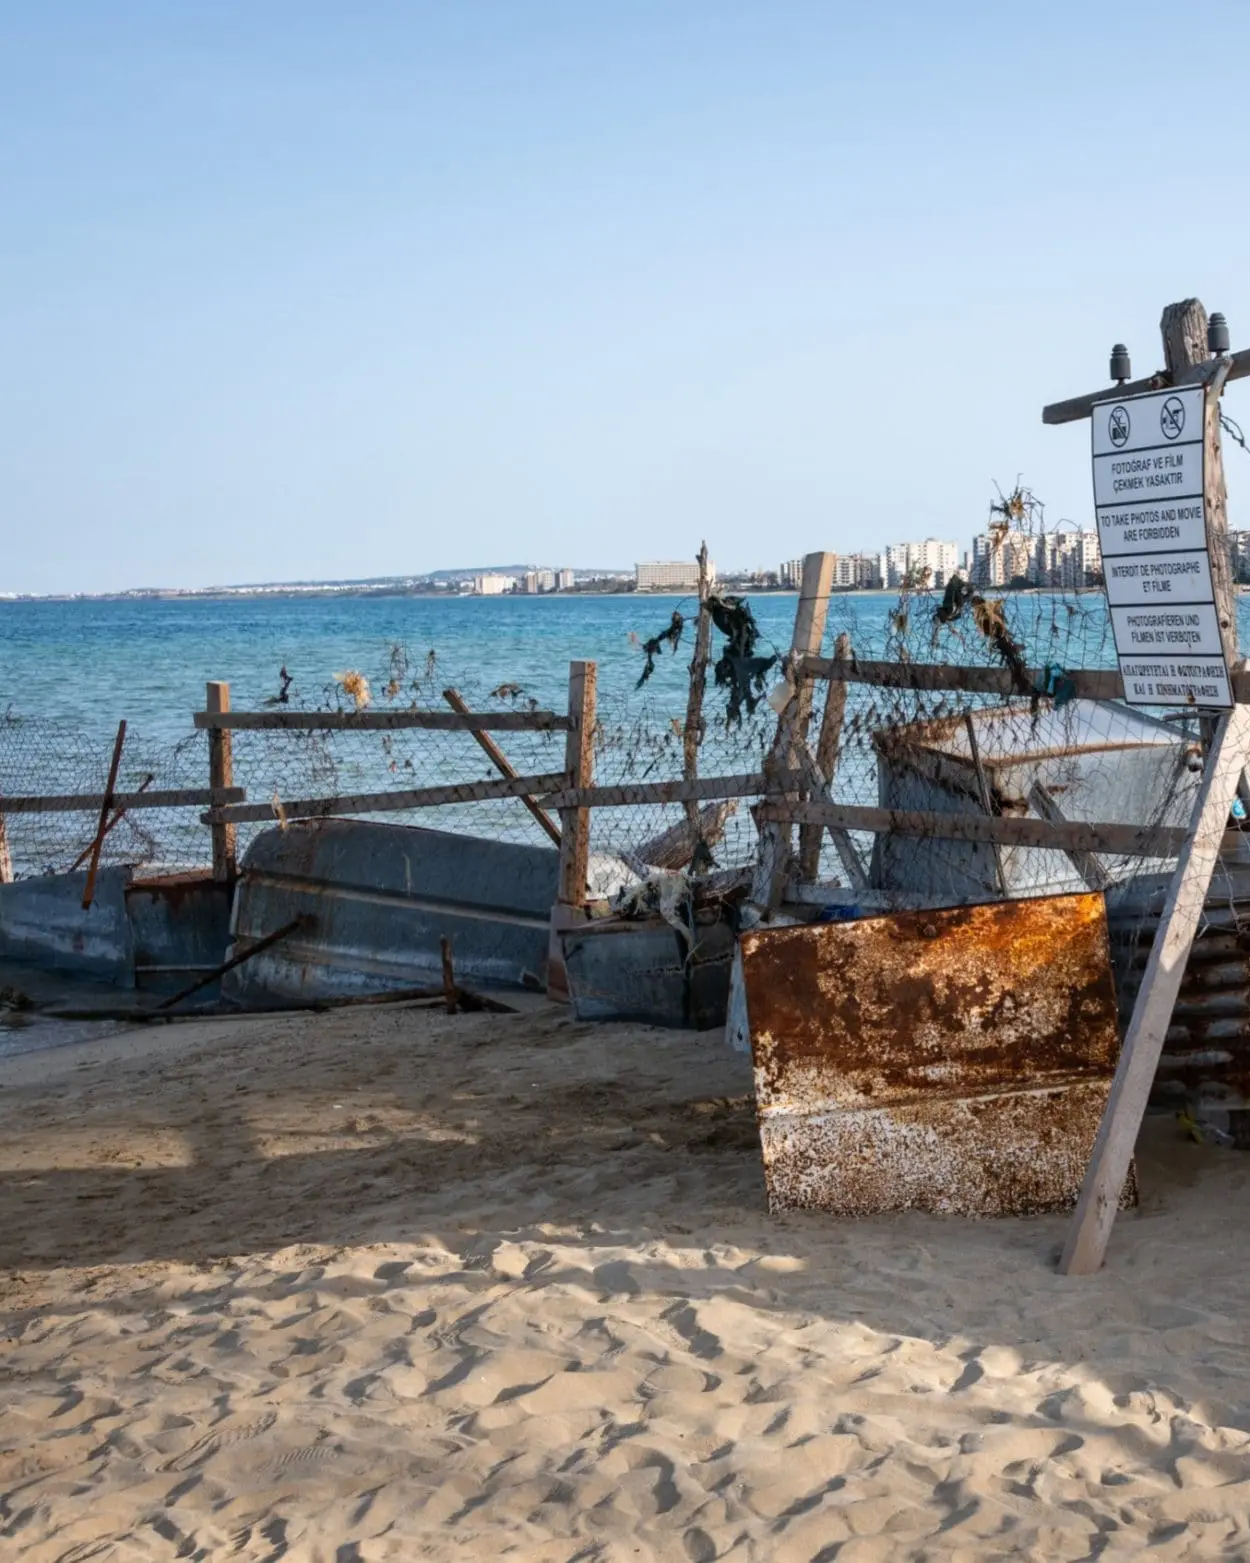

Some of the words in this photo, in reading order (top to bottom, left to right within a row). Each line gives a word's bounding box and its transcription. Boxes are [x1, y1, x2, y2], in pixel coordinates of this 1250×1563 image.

[1153, 456, 1163, 469] VE
[1113, 477, 1143, 494] ÇEKMEK
[1146, 472, 1183, 488] YASAKTIR
[1100, 515, 1110, 527] TO
[1112, 513, 1130, 526] TAKE
[1131, 511, 1159, 525] PHOTOS
[1161, 509, 1176, 521] AND
[1123, 529, 1138, 542] ARE
[1139, 526, 1180, 541] FORBIDDEN
[1140, 564, 1150, 576] DE
[1143, 581, 1152, 593] ET
[1185, 614, 1200, 626] UND
